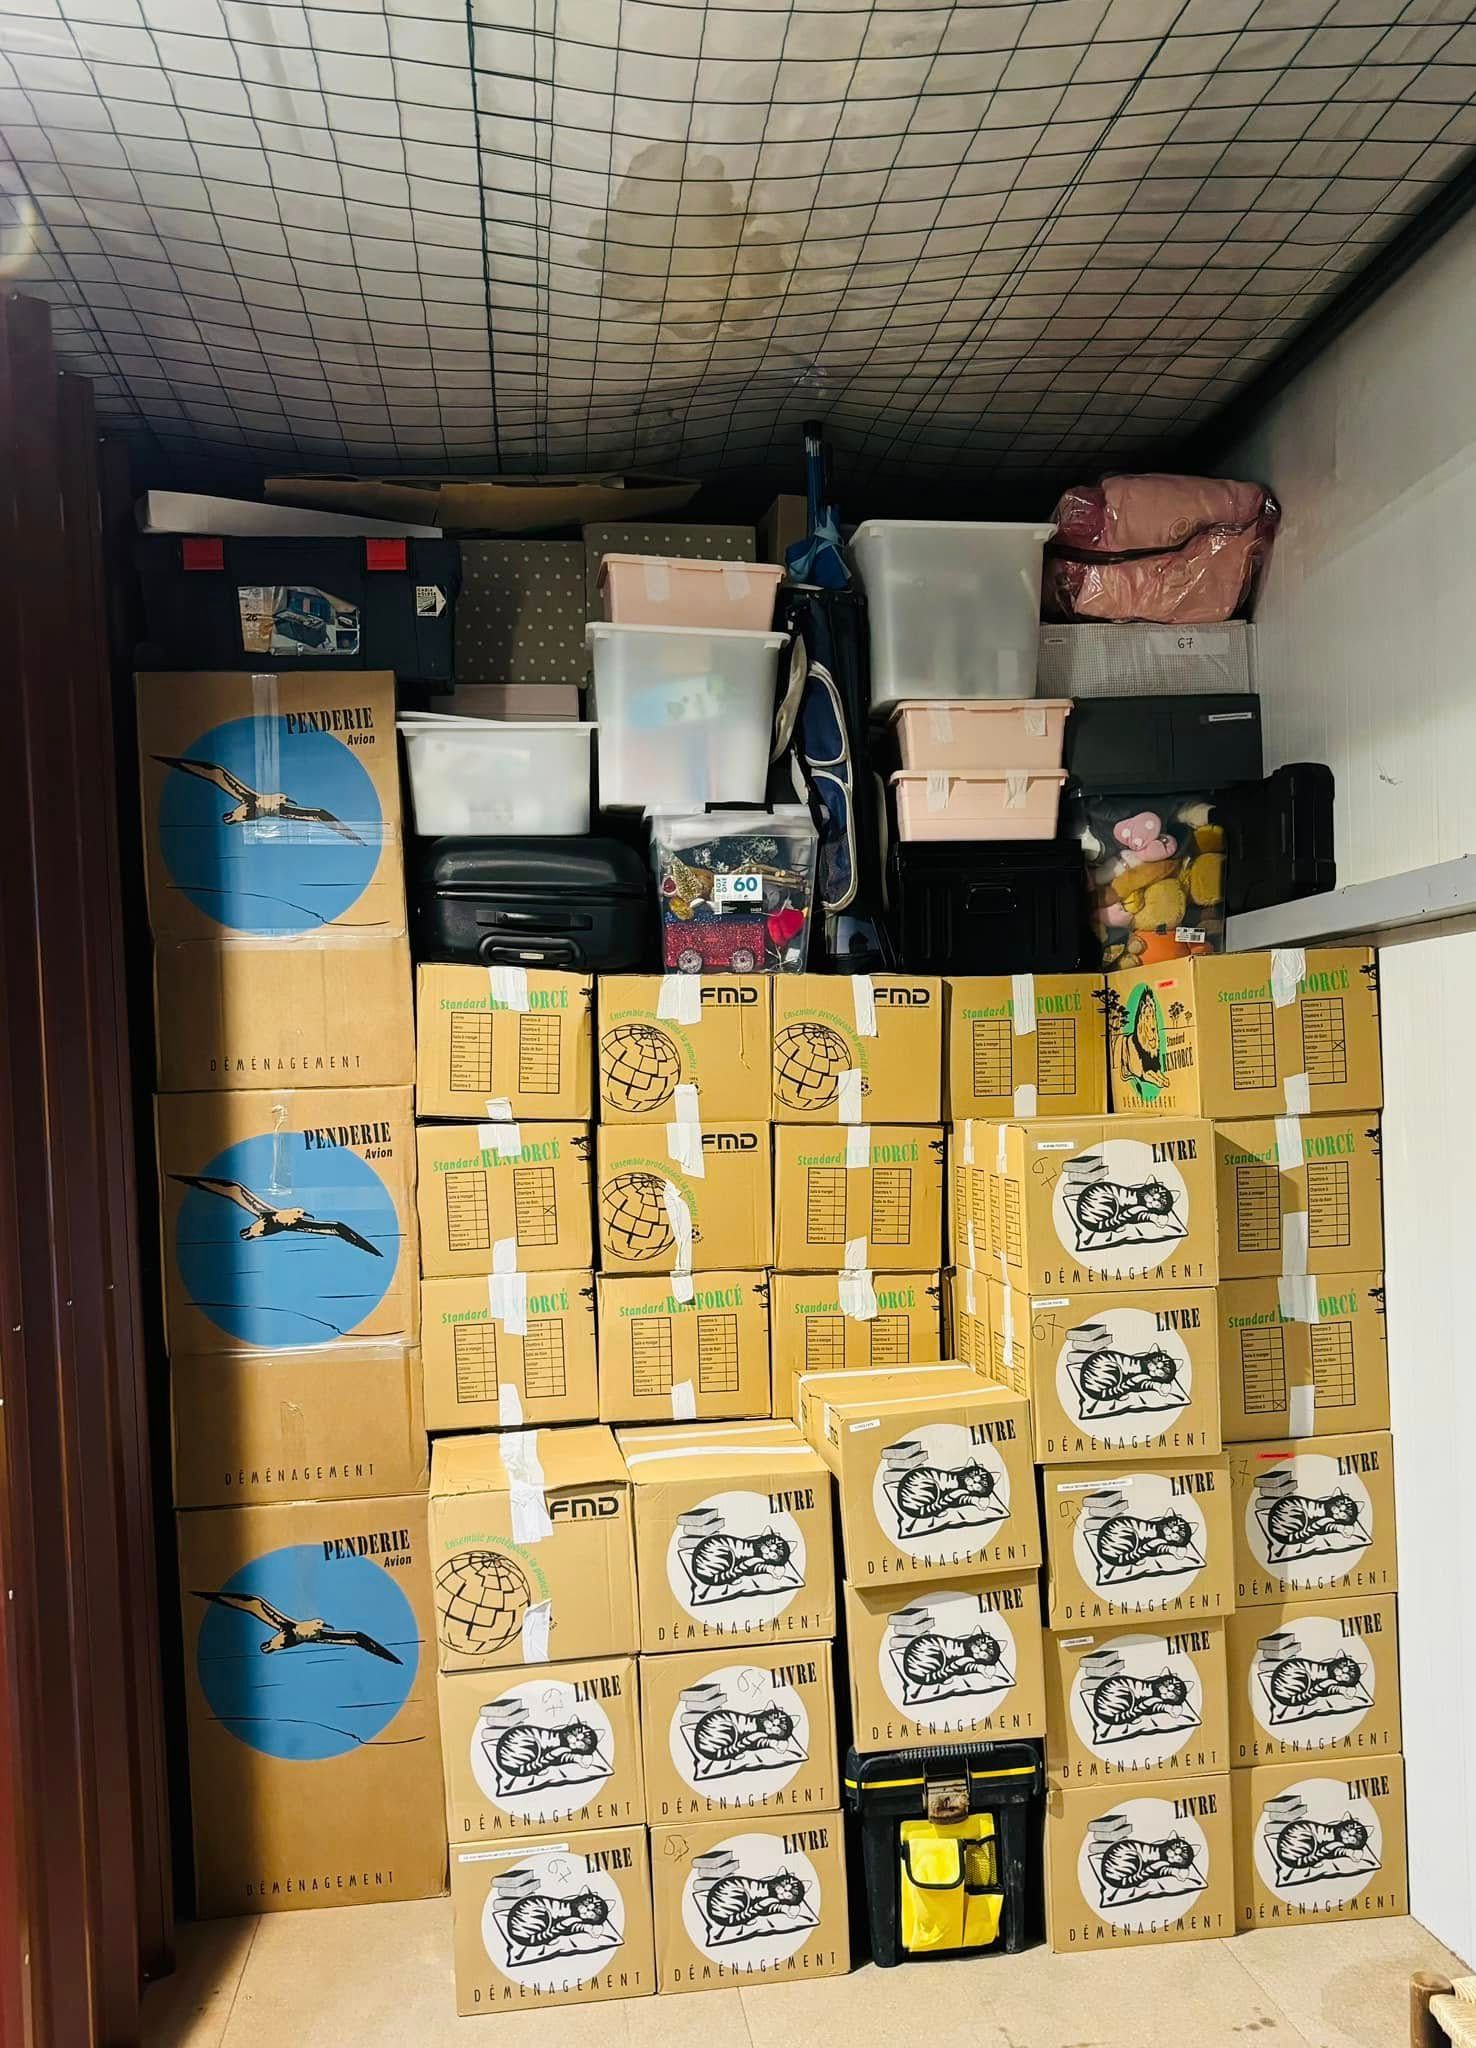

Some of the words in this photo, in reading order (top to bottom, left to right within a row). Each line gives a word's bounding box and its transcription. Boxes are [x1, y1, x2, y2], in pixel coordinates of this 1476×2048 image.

[1177, 637, 1194, 649] 67
[285, 707, 374, 735] PENDERIE
[347, 733, 376, 746] Avion
[733, 876, 758, 892] 60
[440, 998, 487, 1011] Standard
[700, 987, 759, 1004] FMD
[873, 987, 931, 1005] FMD
[1217, 986, 1265, 1003] Standard
[962, 1005, 1006, 1020] Standard
[211, 1055, 361, 1072] DÉMÉNAGEMENT
[303, 1122, 392, 1151] PENDERIE
[701, 1133, 759, 1150] FMD
[364, 1148, 393, 1160] Avion
[797, 1153, 841, 1166] Standard
[1151, 1138, 1198, 1164] LIVRE
[1224, 1149, 1271, 1166] Standard
[433, 1156, 479, 1173] Standard
[1044, 1264, 1204, 1285] DÉMÉNAGEMENT
[442, 1308, 488, 1324] Standard
[620, 1302, 664, 1317] Standard
[794, 1301, 839, 1314] Standard
[1155, 1307, 1201, 1332] LIVRE
[1228, 1311, 1275, 1328] Standard
[1031, 1313, 1065, 1348] 67
[969, 1419, 1016, 1446] LIVRE
[1047, 1432, 1206, 1453] DÉMÉNAGEMENT
[225, 1464, 374, 1486] DÉMÉNAGEMENT
[1337, 1451, 1380, 1476] LIVRE
[1170, 1471, 1215, 1497] LIVRE
[550, 1496, 619, 1521] FMD
[768, 1488, 815, 1514] LIVRE
[323, 1529, 411, 1562] PENDERIE
[384, 1556, 412, 1568] Avion
[867, 1544, 1028, 1574] DÉMÉNAGEMENT
[1239, 1570, 1388, 1597] DÉMÉNAGEMENT
[977, 1587, 1024, 1614] LIVRE
[1065, 1593, 1222, 1619] DÉMÉNAGEMENT
[658, 1614, 821, 1641] DÉMÉNAGEMENT
[1340, 1613, 1382, 1638] LIVRE
[1166, 1630, 1210, 1656] LIVRE
[770, 1662, 817, 1689] LIVRE
[574, 1675, 622, 1703] LIVRE
[872, 1713, 1032, 1740] DÉMÉNAGEMENT
[1239, 1731, 1389, 1757] DÉMÉNAGEMENT
[1063, 1751, 1218, 1778] DÉMÉNAGEMENT
[662, 1787, 825, 1815] DÉMÉNAGEMENT
[1347, 1776, 1390, 1800] LIVRE
[464, 1801, 631, 1832] DÉMÉNAGEMENT
[1174, 1793, 1218, 1820] LIVRE
[783, 1828, 829, 1855] LIVRE
[585, 1847, 633, 1874] LIVRE
[247, 1871, 394, 1897] DÉMÉNAGEMENT
[1246, 1894, 1396, 1920] DÉMÉNAGEMENT
[1069, 1914, 1223, 1942] DÉMÉNAGEMENT
[674, 1951, 836, 1981] DÉMÉNAGEMENT
[474, 1971, 641, 2002] DÉMÉNAGEMENT
